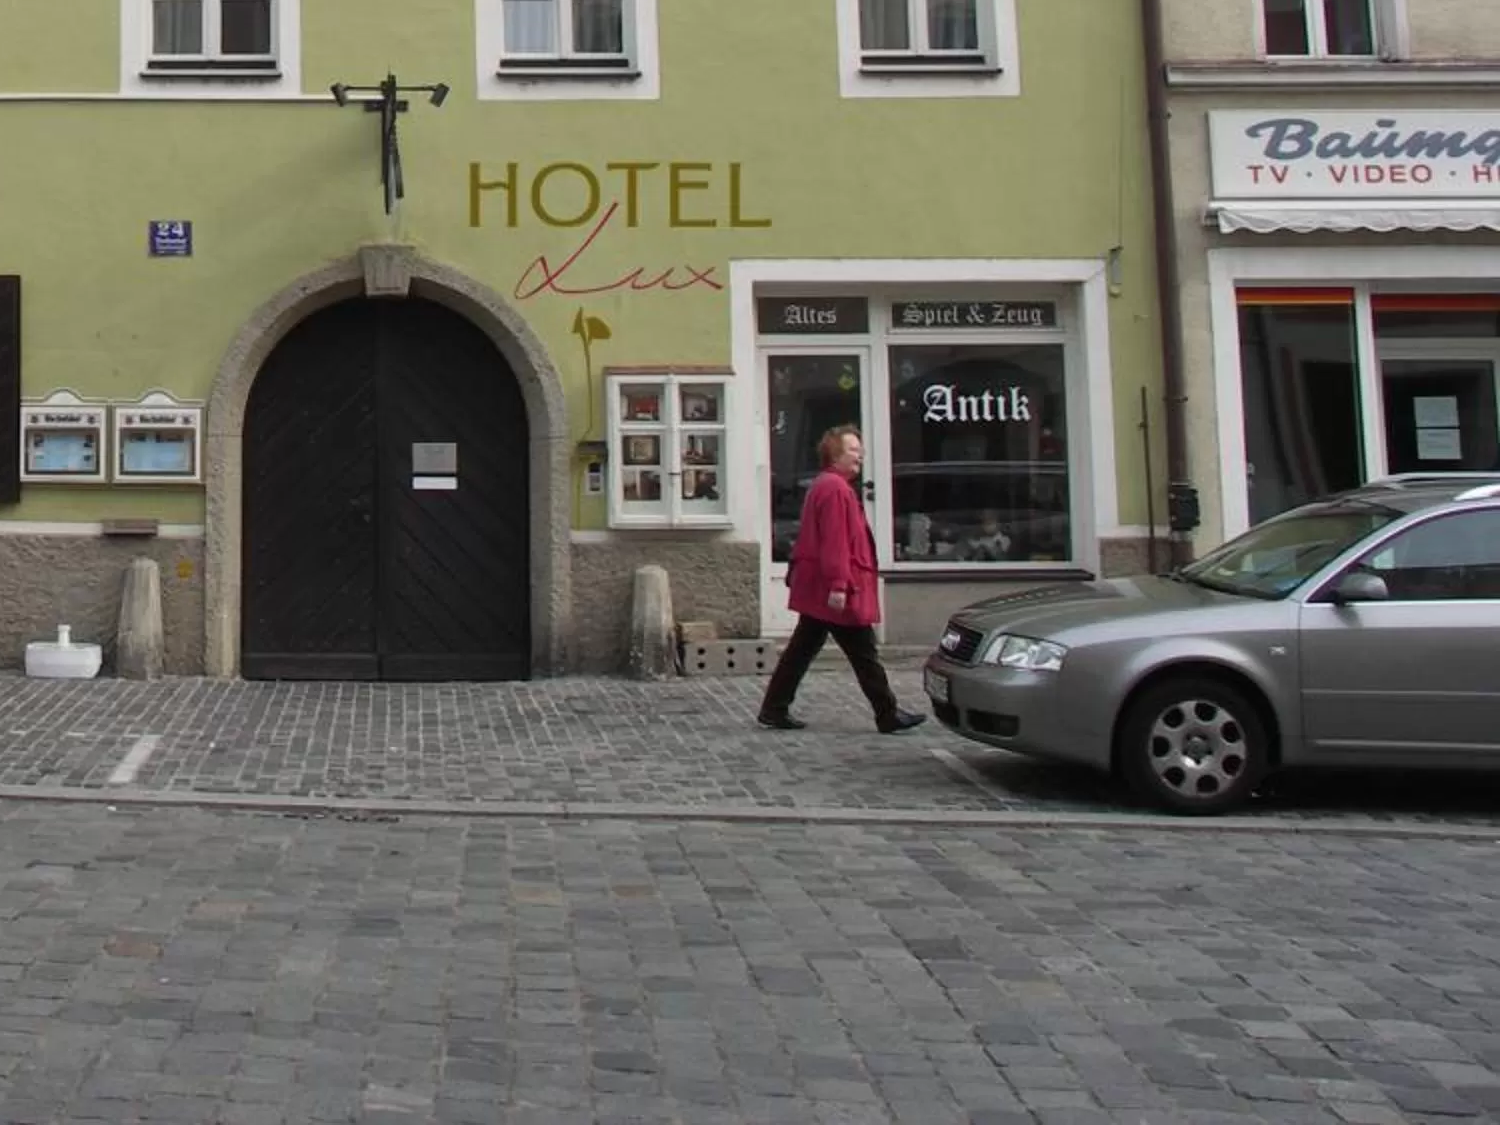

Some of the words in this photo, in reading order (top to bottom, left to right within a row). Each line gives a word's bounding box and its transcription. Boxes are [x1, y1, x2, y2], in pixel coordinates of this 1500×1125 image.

[1247, 165, 1290, 184] TV
[1328, 164, 1433, 184] VIDEO
[469, 162, 773, 228] HOTEL
[514, 201, 723, 300] Lux
[784, 304, 838, 325] Altes
[902, 303, 960, 326] Spiel
[966, 303, 986, 324] &
[991, 303, 1044, 326] Zeug
[923, 384, 1032, 423] Antik
